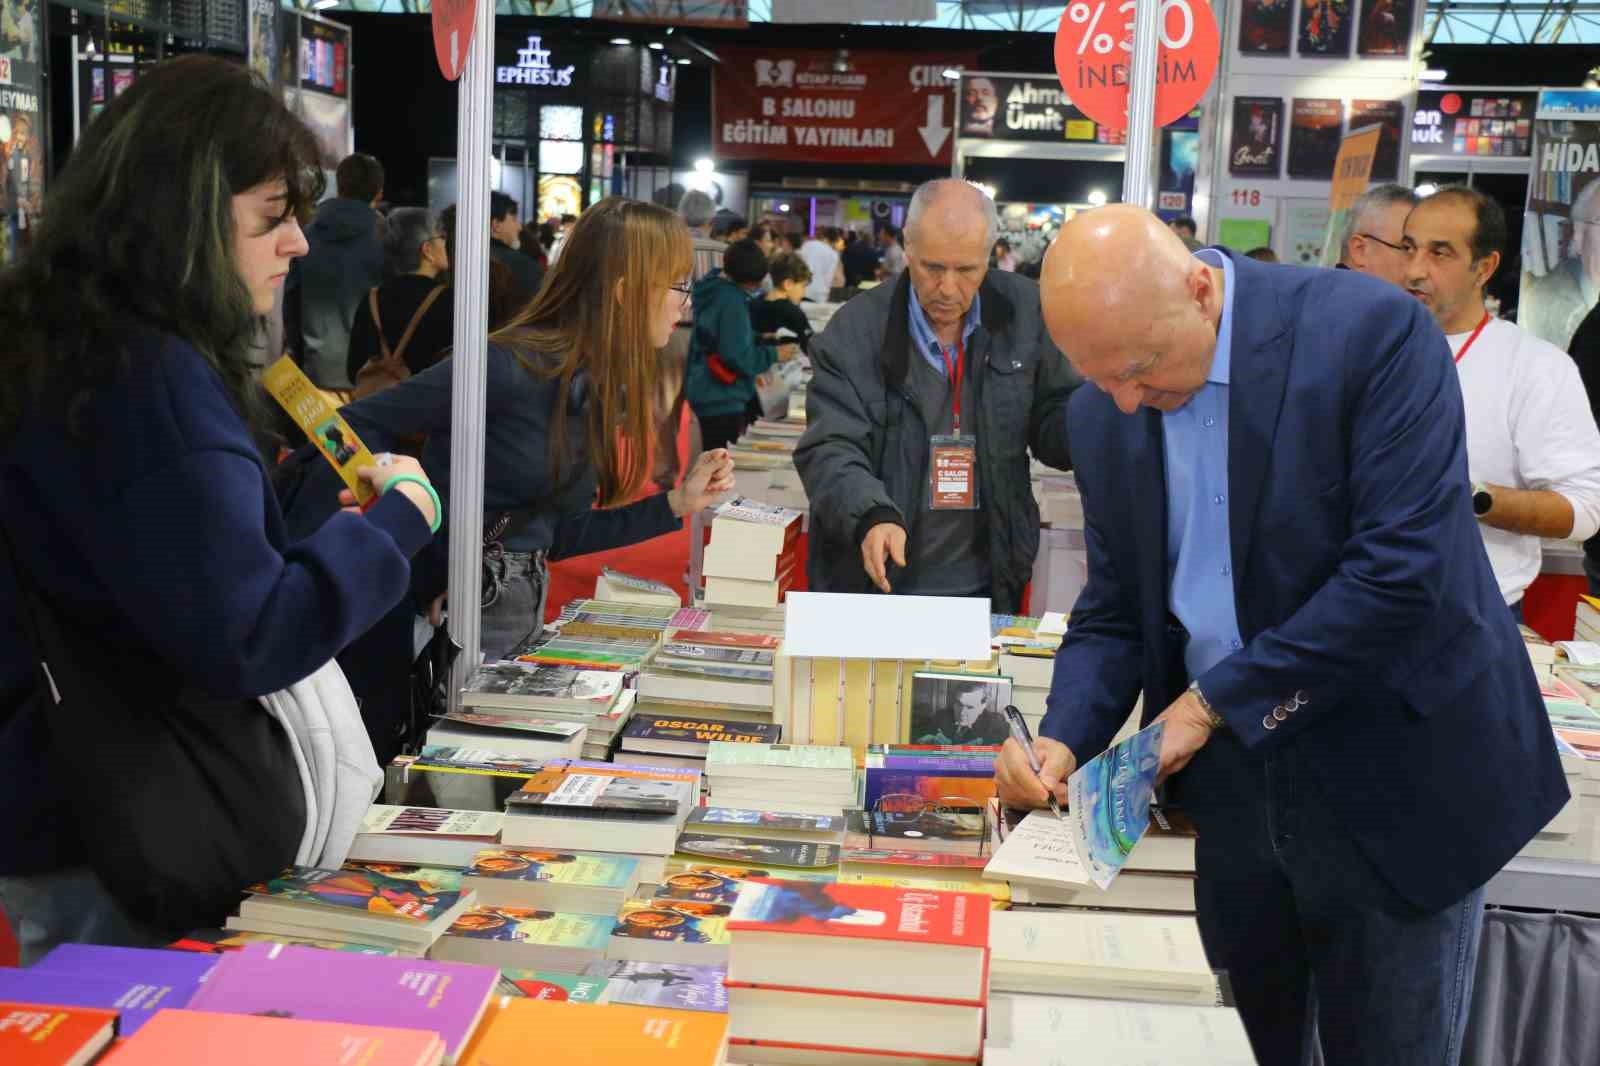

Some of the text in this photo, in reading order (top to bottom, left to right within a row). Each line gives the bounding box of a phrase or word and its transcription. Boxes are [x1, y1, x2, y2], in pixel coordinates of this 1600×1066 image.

[496, 66, 572, 85] EPHESUS
[0, 89, 38, 112] EYMAR
[763, 98, 855, 119] B SALONU
[1006, 103, 1063, 130] Ümit
[723, 119, 894, 147] EĞİTİM YAYINLARI
[1232, 189, 1260, 206] 118
[654, 719, 725, 732] OSCAR
[695, 730, 763, 744] WILDE
